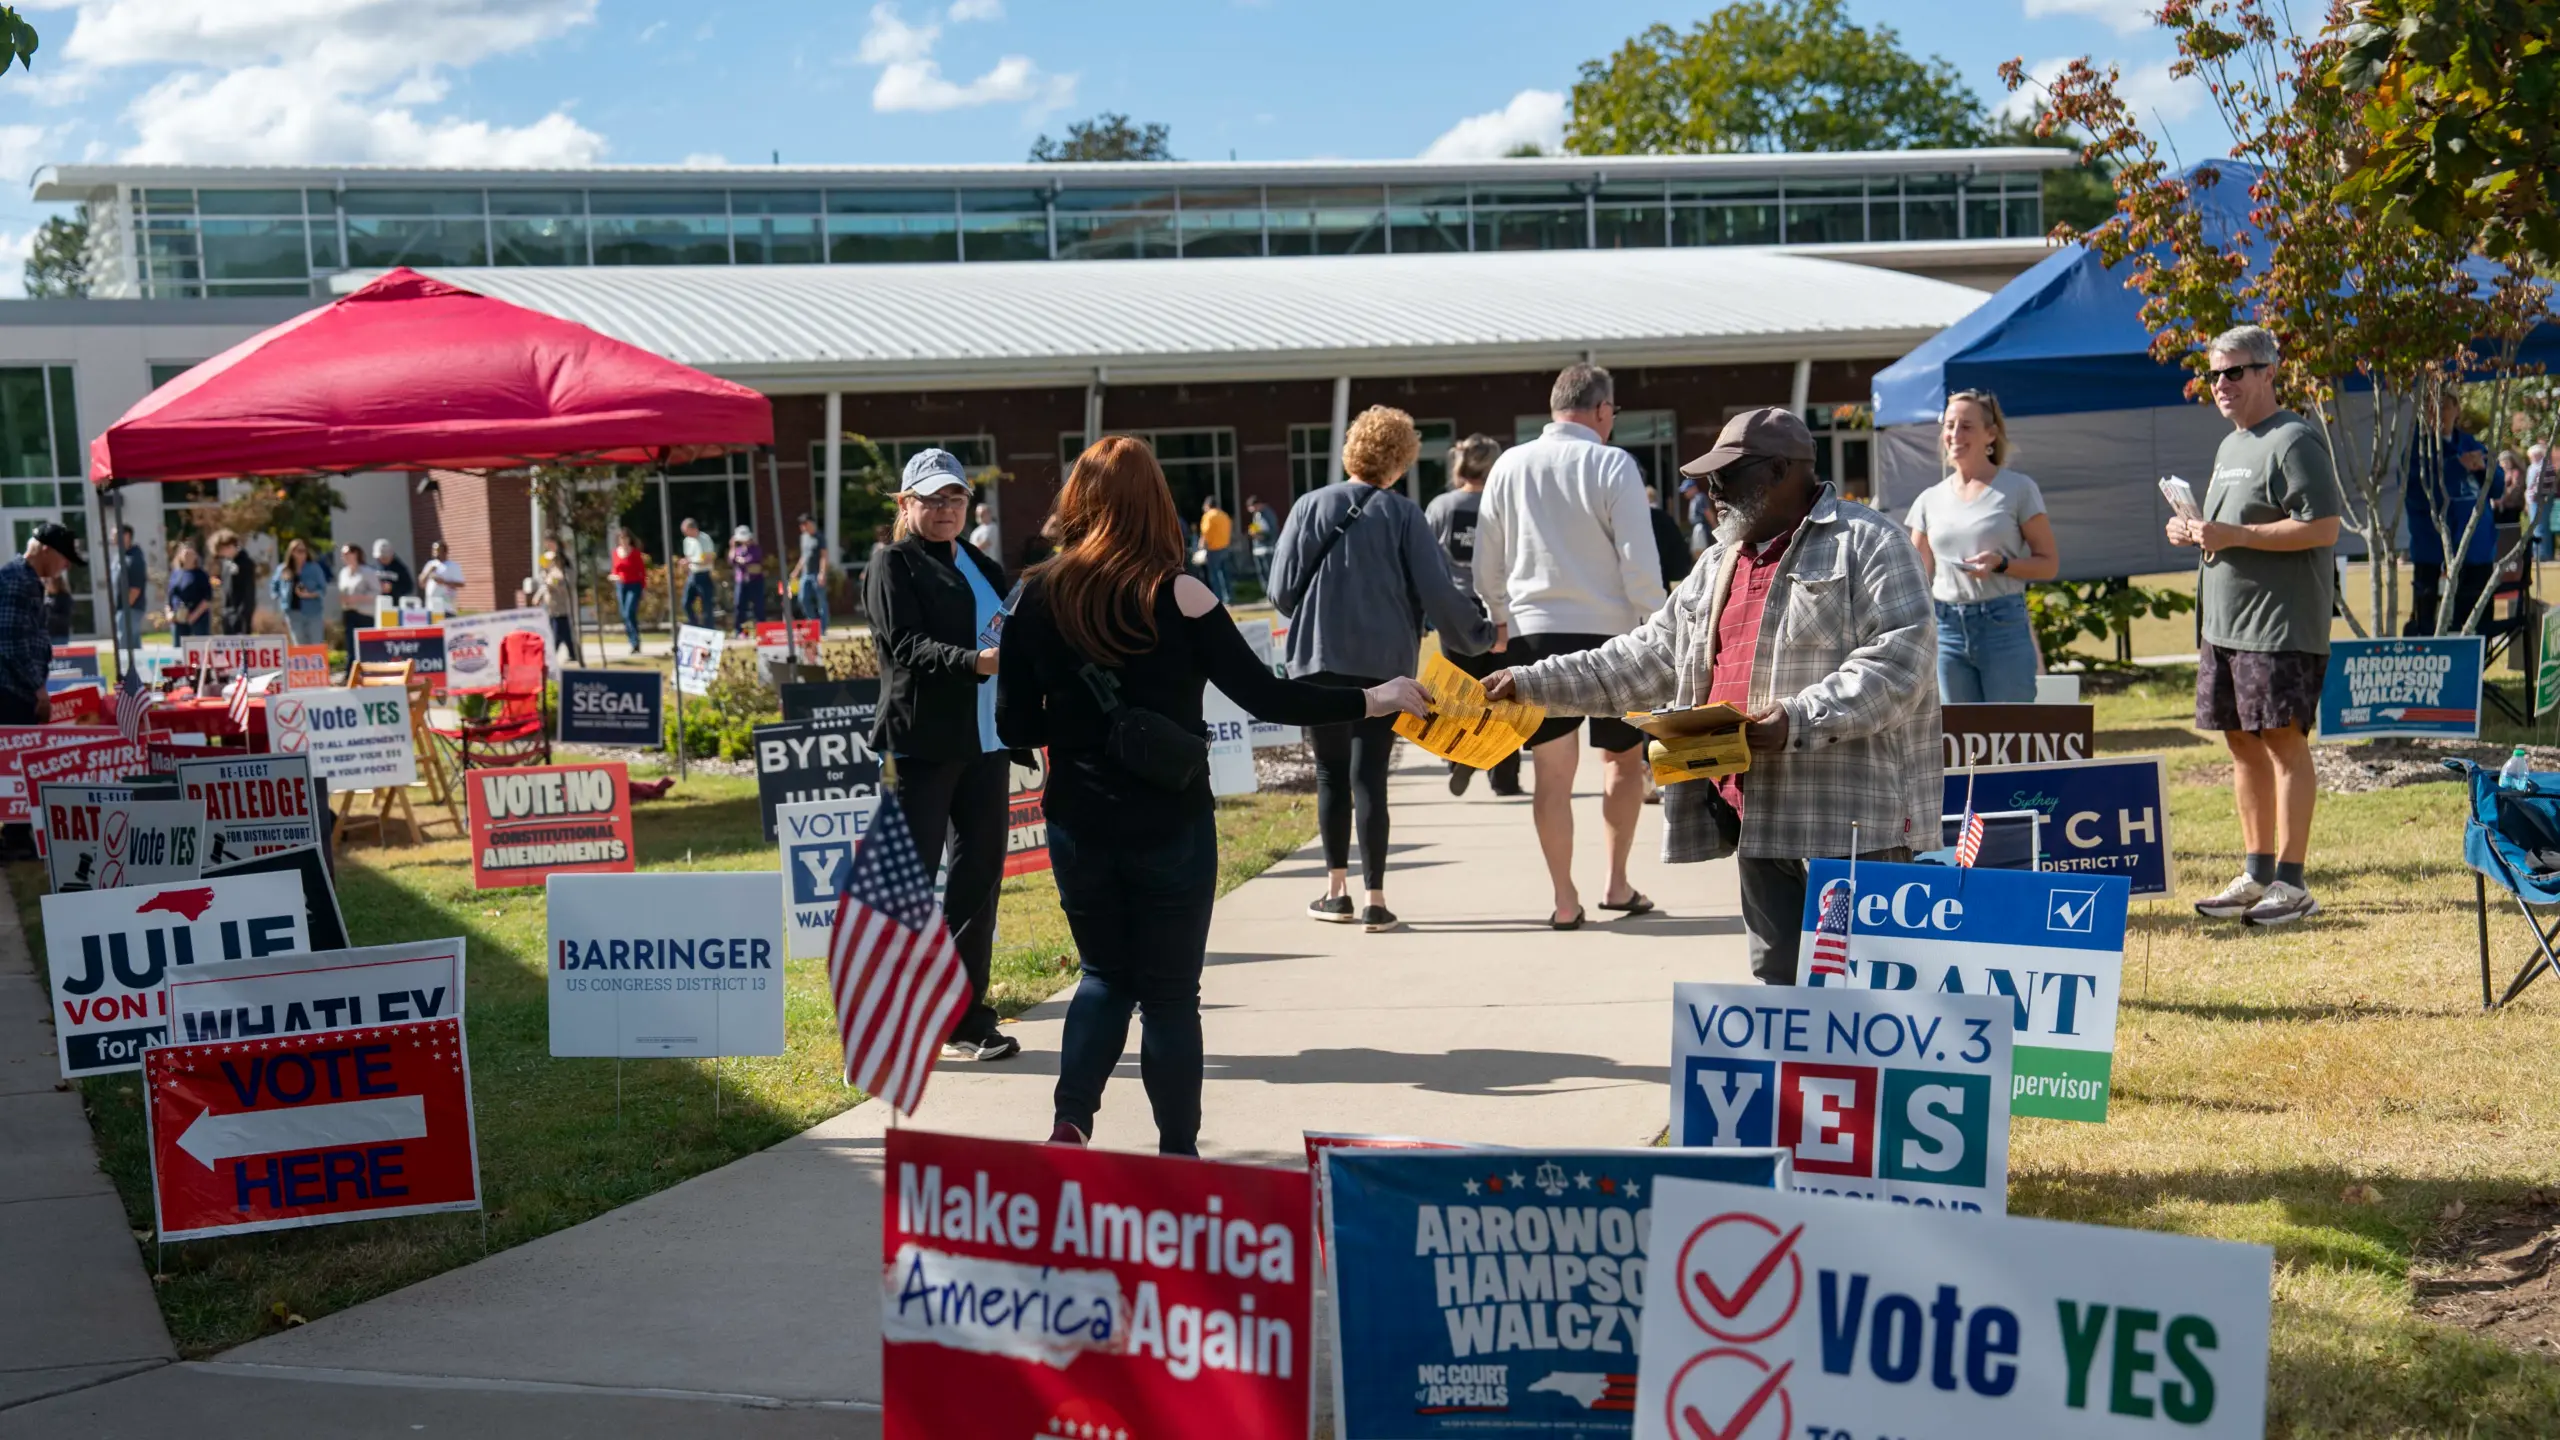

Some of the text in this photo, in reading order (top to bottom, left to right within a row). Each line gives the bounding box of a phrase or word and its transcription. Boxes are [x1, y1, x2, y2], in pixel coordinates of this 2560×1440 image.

[384, 641, 419, 656] Tyler
[2344, 655, 2451, 675] ARROWOOD
[2350, 671, 2444, 690] HAMPSON
[573, 692, 650, 713] SEGAL
[2351, 687, 2440, 707] WALCZYK
[308, 701, 400, 731] Vote YES
[328, 740, 344, 748] ALL
[347, 734, 406, 747] AMENDMENTS
[760, 730, 879, 774] BYRN
[1943, 732, 2084, 765] OPKINS
[27, 750, 82, 778] ELECT
[86, 744, 147, 770] SHIRL
[152, 752, 179, 771] Mak
[220, 764, 269, 779] RE-ELECT
[334, 754, 357, 763] KEEP
[359, 751, 382, 760] YOUR
[338, 767, 361, 776] YOUR
[364, 763, 397, 774] POCKET
[827, 770, 844, 781] for
[482, 769, 614, 818] VOTE NO
[2009, 791, 2060, 813] Sydney
[226, 827, 311, 843] FOR DISTRICT COURT
[490, 825, 615, 845] CONSTITUTIONAL
[788, 810, 870, 838] VOTE
[130, 826, 196, 866] Vote YES
[482, 840, 627, 871] AMENDMENTS
[2042, 853, 2139, 873] DISTRICT 17
[796, 909, 836, 929] WAK
[559, 938, 772, 970] BARRINGER
[566, 977, 766, 991] US CONGRESS DISTRICT 13
[1808, 960, 2096, 1036] RANT
[63, 992, 148, 1026] VON
[1689, 1003, 1992, 1063] VOTE NOV. 3
[97, 1038, 137, 1061] for
[220, 1044, 398, 1108] VOTE
[2013, 1072, 2102, 1101] pervisor
[1697, 1069, 1966, 1173] YES
[235, 1146, 409, 1212] HERE
[899, 1161, 1295, 1284] Make America
[1415, 1205, 1651, 1256] ARROWO
[1434, 1253, 1649, 1308] HAMPSO
[898, 1251, 1114, 1340] America
[1127, 1281, 1292, 1381] Again
[1444, 1302, 1644, 1358] WALCZY
[1817, 1267, 2220, 1426] Vote YES
[1418, 1364, 1508, 1385] NC COURT
[1415, 1384, 1509, 1406] of APPEALS
